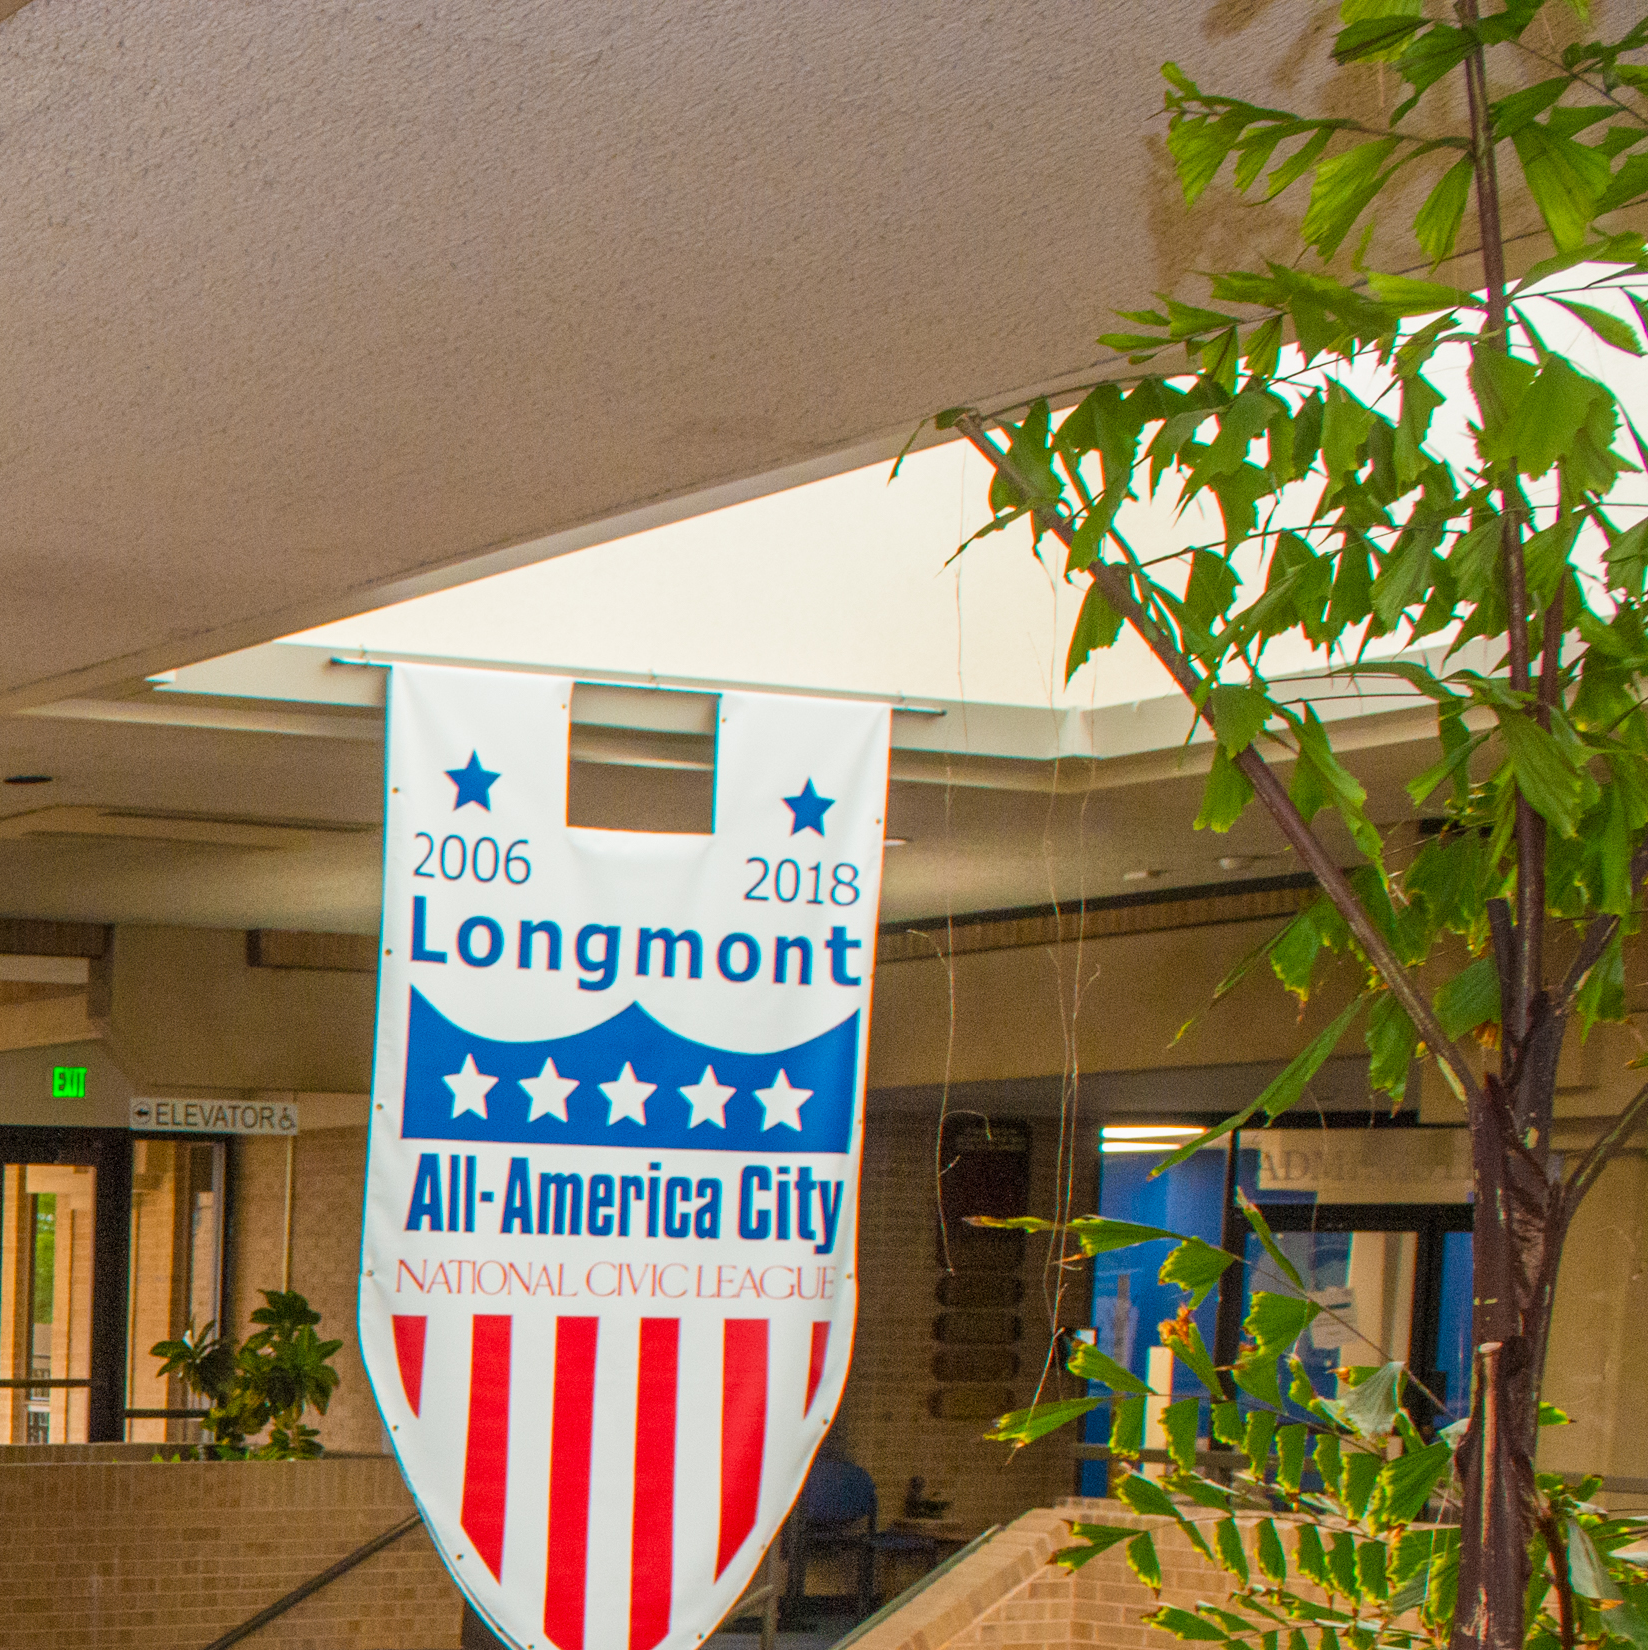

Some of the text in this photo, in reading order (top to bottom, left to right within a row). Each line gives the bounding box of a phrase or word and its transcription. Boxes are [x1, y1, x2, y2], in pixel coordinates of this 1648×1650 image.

[413, 831, 532, 885] 2006
[743, 857, 861, 906] 2018
[409, 895, 862, 991] Longmont
[53, 1066, 87, 1098] EXIT
[156, 1102, 275, 1129] ELEVATOR
[404, 1152, 844, 1255] All-America City
[395, 1258, 836, 1301] NATIONAL CIVIC LEAGUE
